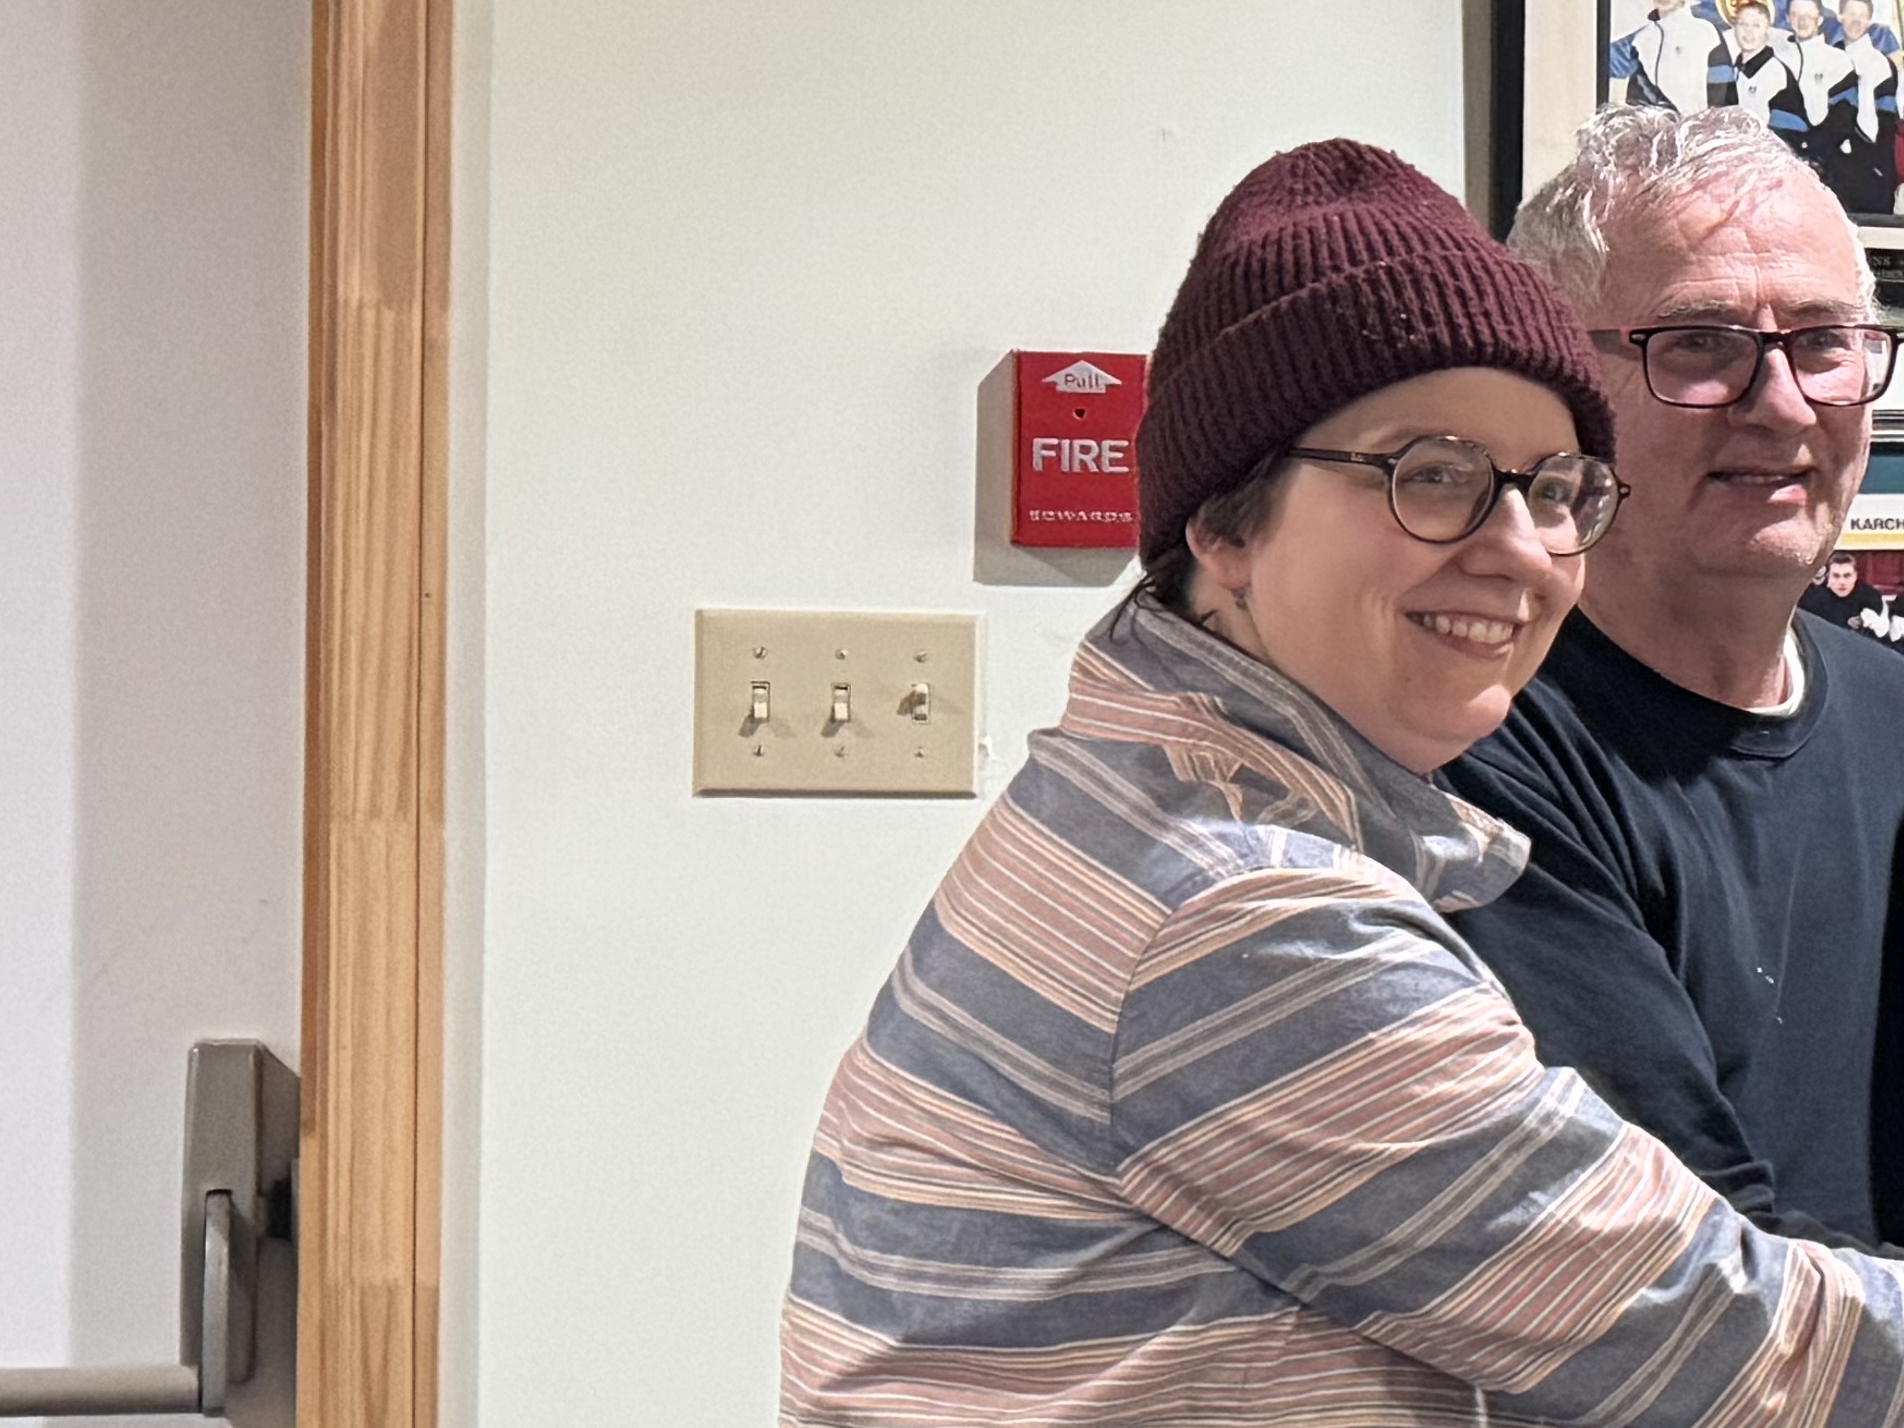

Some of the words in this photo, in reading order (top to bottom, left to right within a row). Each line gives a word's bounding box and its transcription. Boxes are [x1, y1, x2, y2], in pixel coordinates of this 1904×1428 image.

[1064, 373, 1101, 389] Pull
[1032, 437, 1130, 474] FIRE
[1029, 509, 1133, 523] EDWARDS
